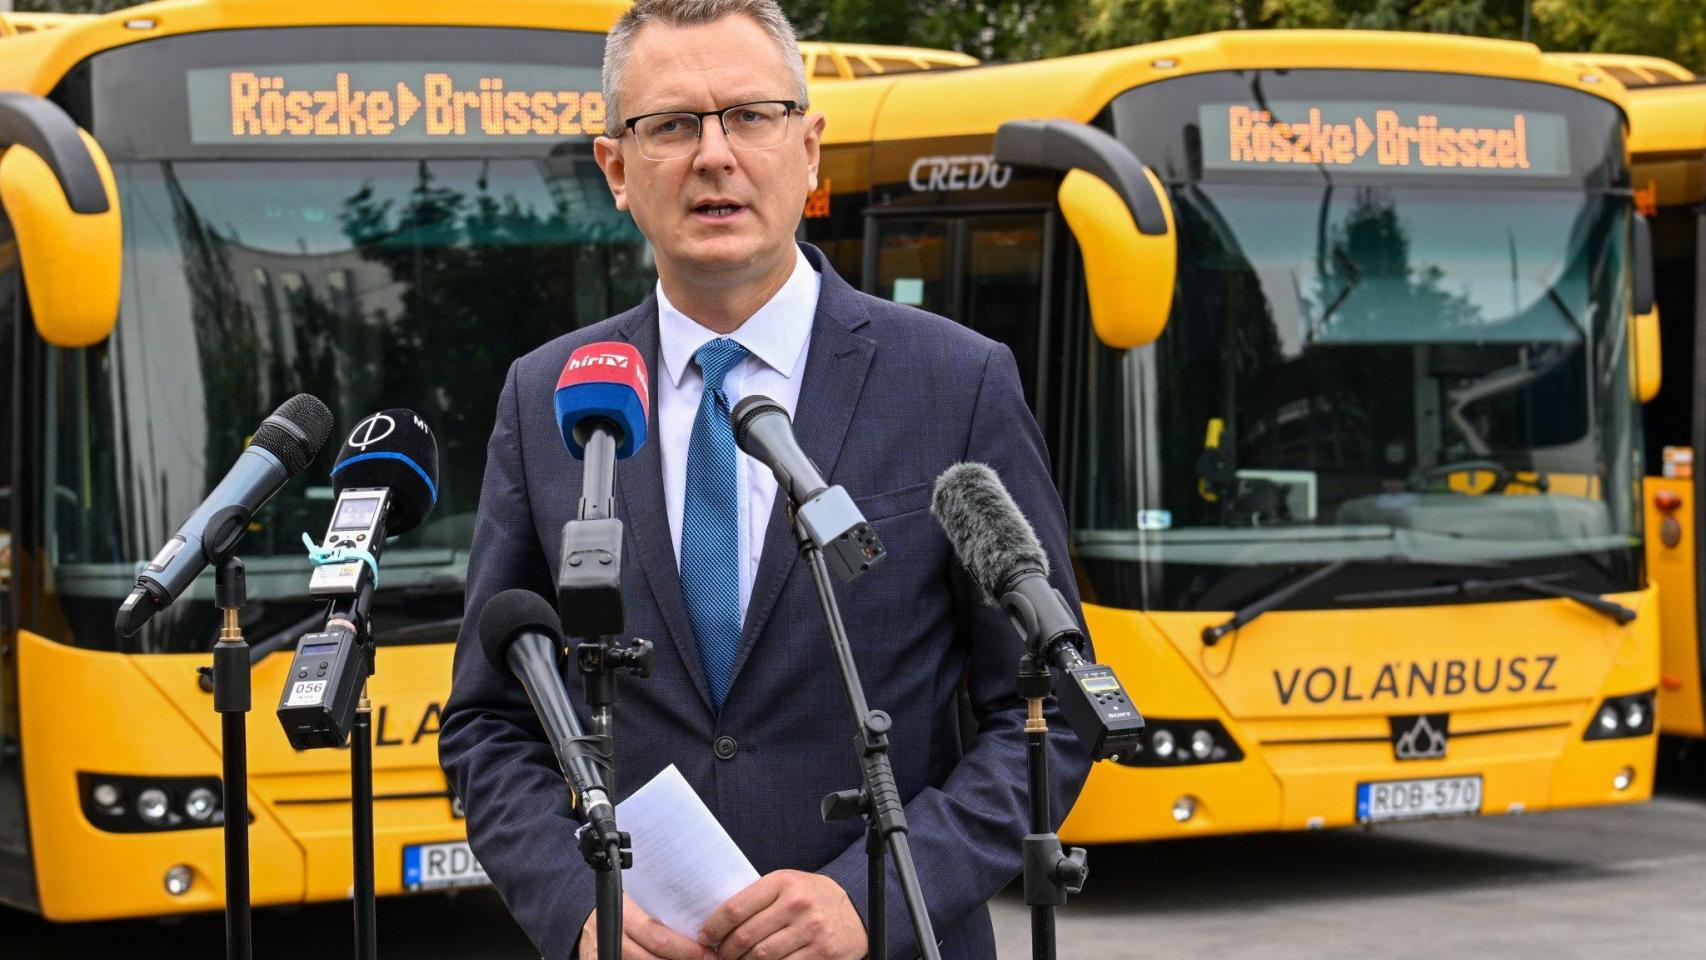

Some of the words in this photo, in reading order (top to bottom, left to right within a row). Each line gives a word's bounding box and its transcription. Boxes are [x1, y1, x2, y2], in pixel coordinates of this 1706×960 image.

[230, 72, 395, 135] Röszke
[1229, 106, 1355, 164] Röszke
[1376, 110, 1530, 169] Brüsszel
[909, 154, 1012, 192] CREDO
[413, 415, 428, 434] M1
[295, 682, 322, 695] 056
[1272, 655, 1558, 705] VOLÁNBUSZ
[1107, 711, 1131, 719] SONY
[1374, 780, 1477, 811] RDB-570
